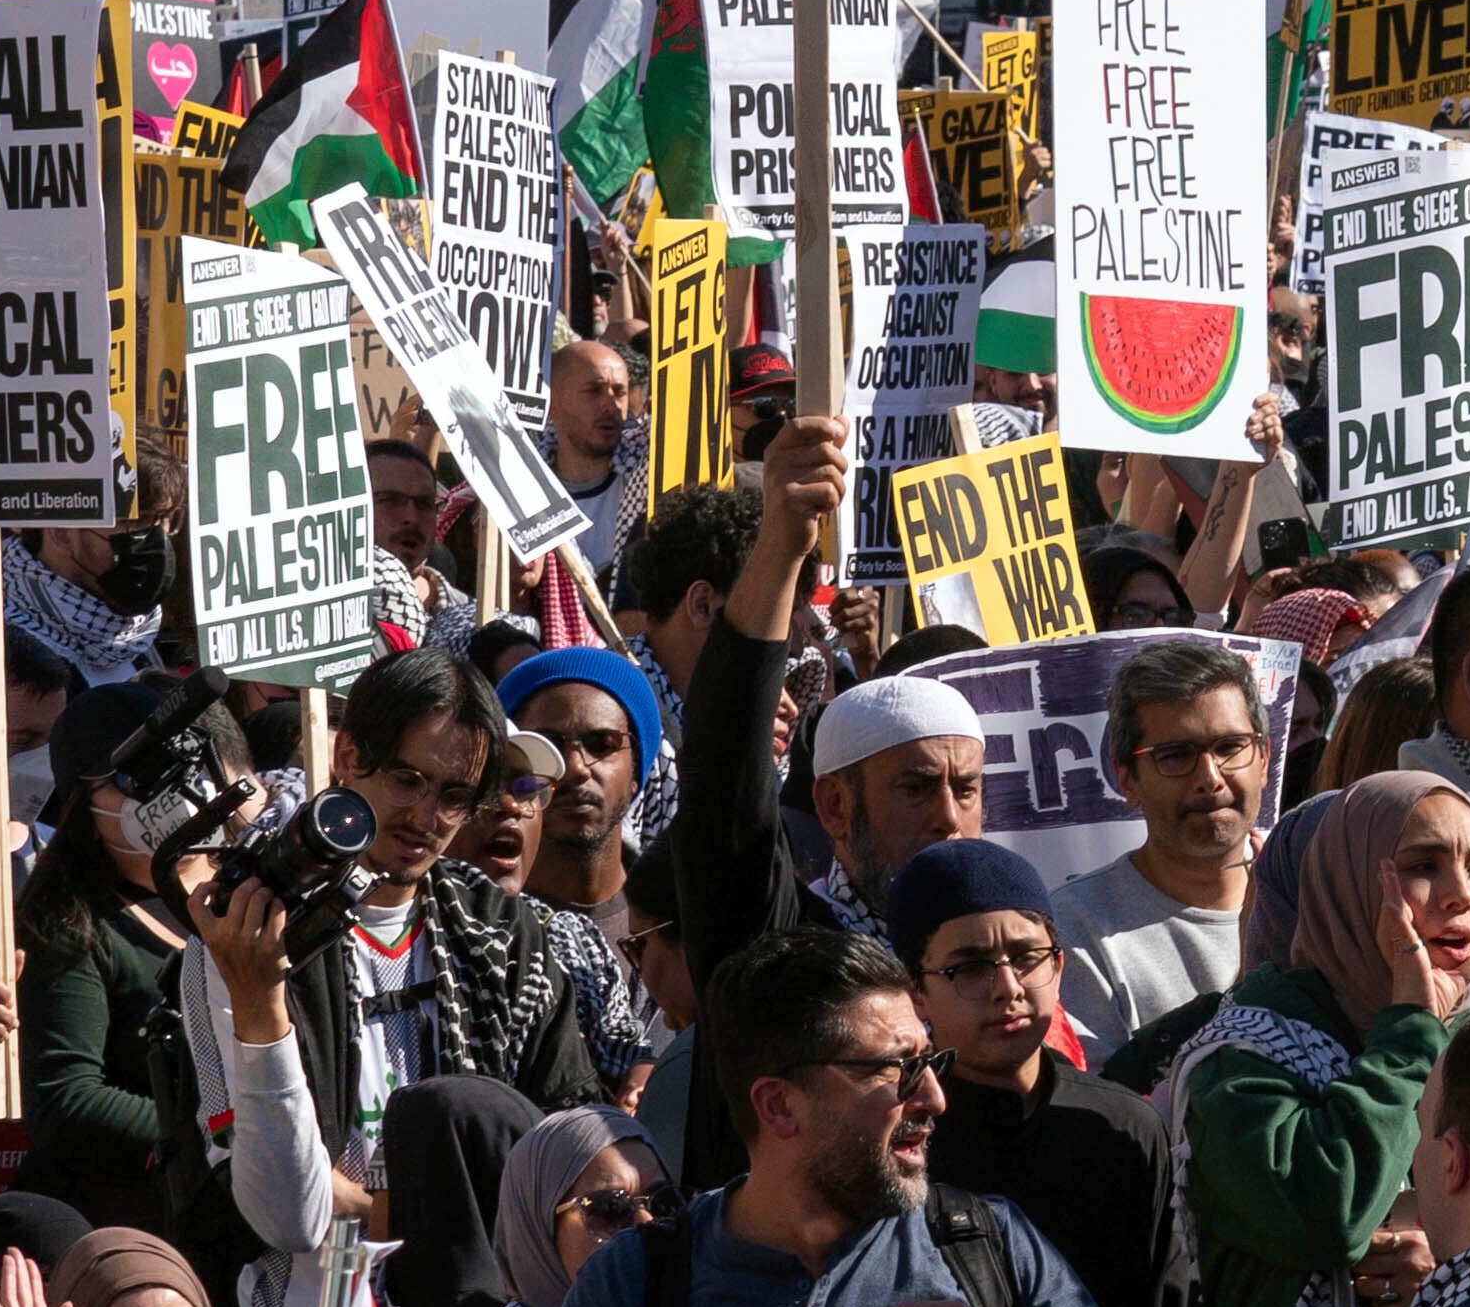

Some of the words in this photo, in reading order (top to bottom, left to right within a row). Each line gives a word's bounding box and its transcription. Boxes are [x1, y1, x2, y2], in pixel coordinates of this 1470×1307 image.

[1103, 62, 1195, 130] FREE
[1109, 134, 1197, 204] FREE
[1333, 160, 1398, 189] ANSWER
[443, 160, 507, 233] END
[517, 175, 558, 246] THE
[1333, 211, 1367, 249] END
[1374, 202, 1406, 242] THE
[1413, 191, 1459, 232] SIEGE
[192, 256, 240, 283] ANSWER
[864, 240, 976, 286] RESISTANCE
[1072, 204, 1246, 292] PALESTINE
[884, 290, 960, 335] AGAINST
[858, 344, 969, 390] OCCUPATION
[194, 340, 367, 526] FREE
[1, 494, 29, 509] and
[34, 492, 98, 509] Liberation
[902, 466, 988, 573] END
[988, 448, 1066, 546] THE
[1343, 494, 1377, 536] END
[1382, 491, 1422, 522] ALL
[1425, 482, 1461, 518] U.S.
[200, 503, 369, 611] PALESTINE!
[991, 544, 1084, 642] WAR
[134, 793, 181, 830] FREE
